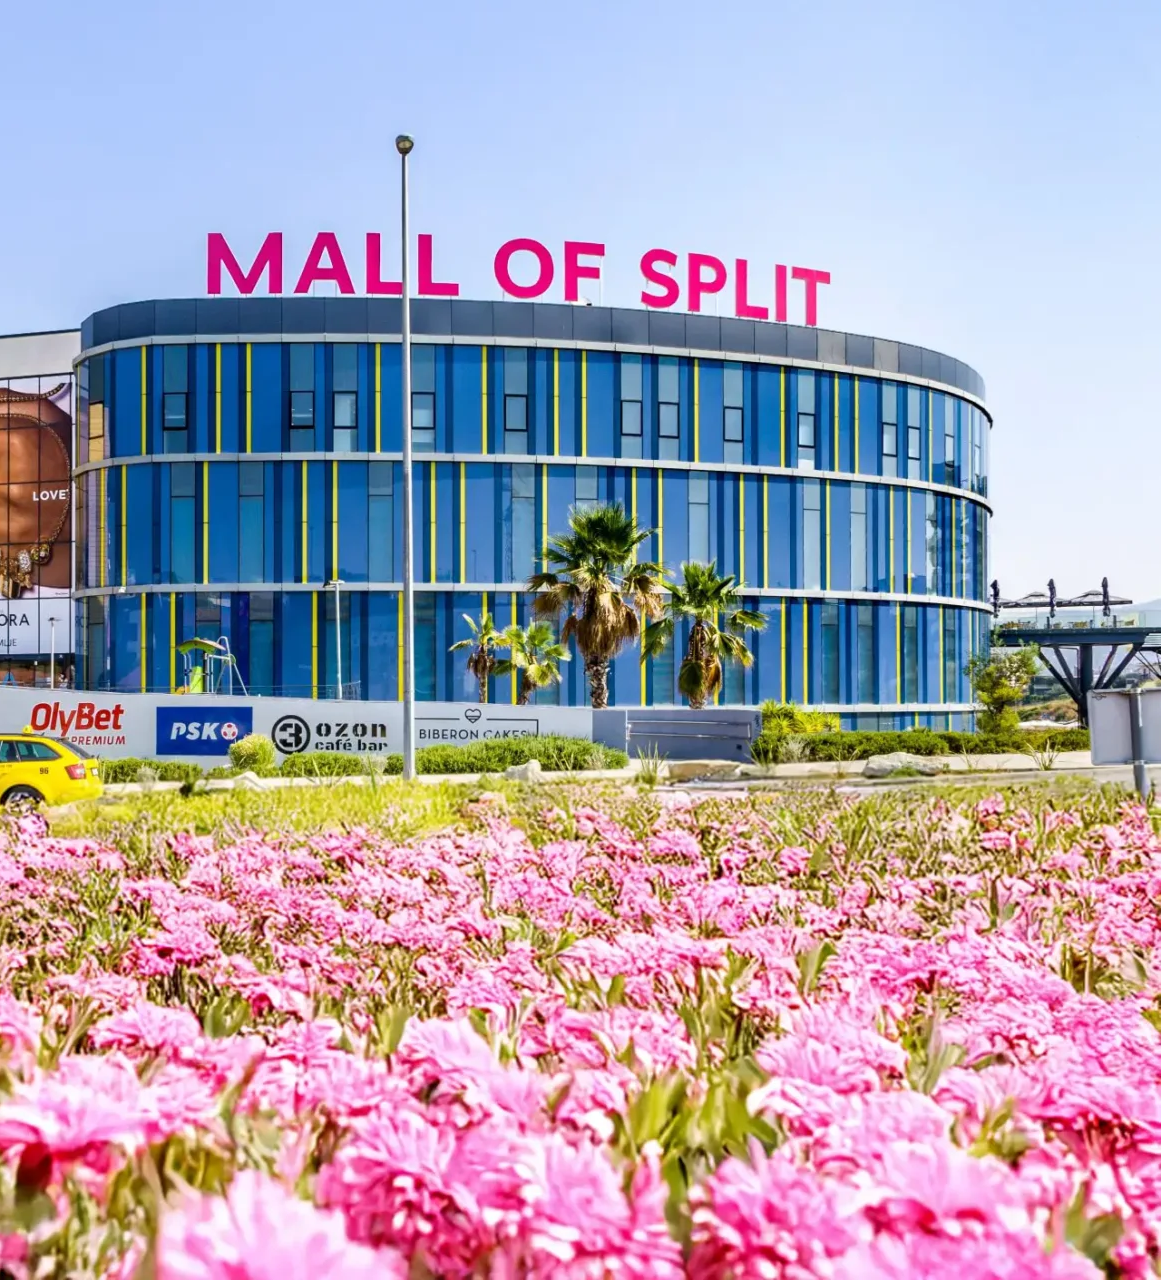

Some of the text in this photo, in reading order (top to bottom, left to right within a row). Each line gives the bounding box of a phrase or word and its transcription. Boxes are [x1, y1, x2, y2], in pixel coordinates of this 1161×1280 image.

[207, 232, 831, 326] MALL OF SPLIT
[31, 702, 124, 736] OlyBet
[170, 722, 219, 740] PSK
[316, 722, 387, 738] ozon
[419, 729, 479, 739] BIBERON
[357, 738, 388, 751] bar
